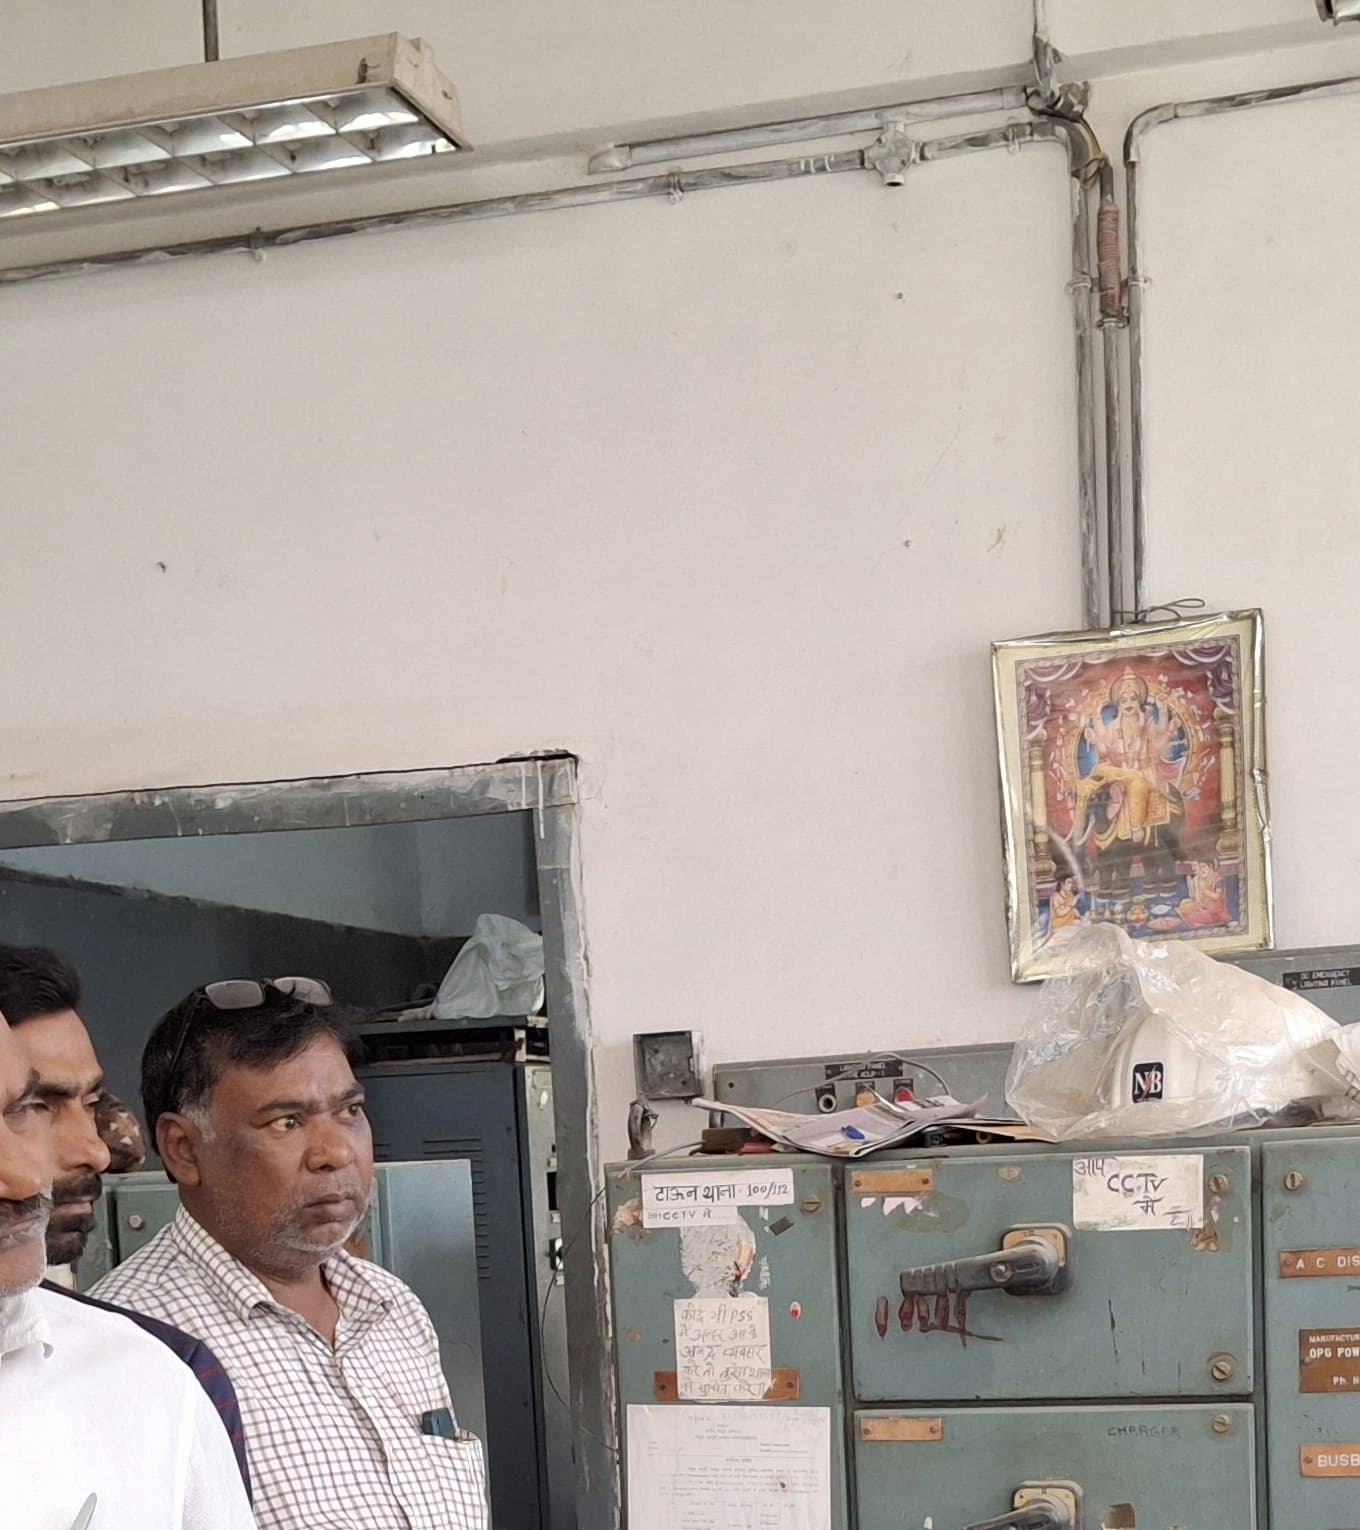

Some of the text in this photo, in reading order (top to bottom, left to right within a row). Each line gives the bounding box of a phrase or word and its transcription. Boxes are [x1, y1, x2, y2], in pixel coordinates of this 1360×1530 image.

[653, 1184, 700, 1202] टाऊन
[702, 1183, 736, 1203] थाना
[1295, 1258, 1305, 1270] A
[1316, 1257, 1326, 1269] C
